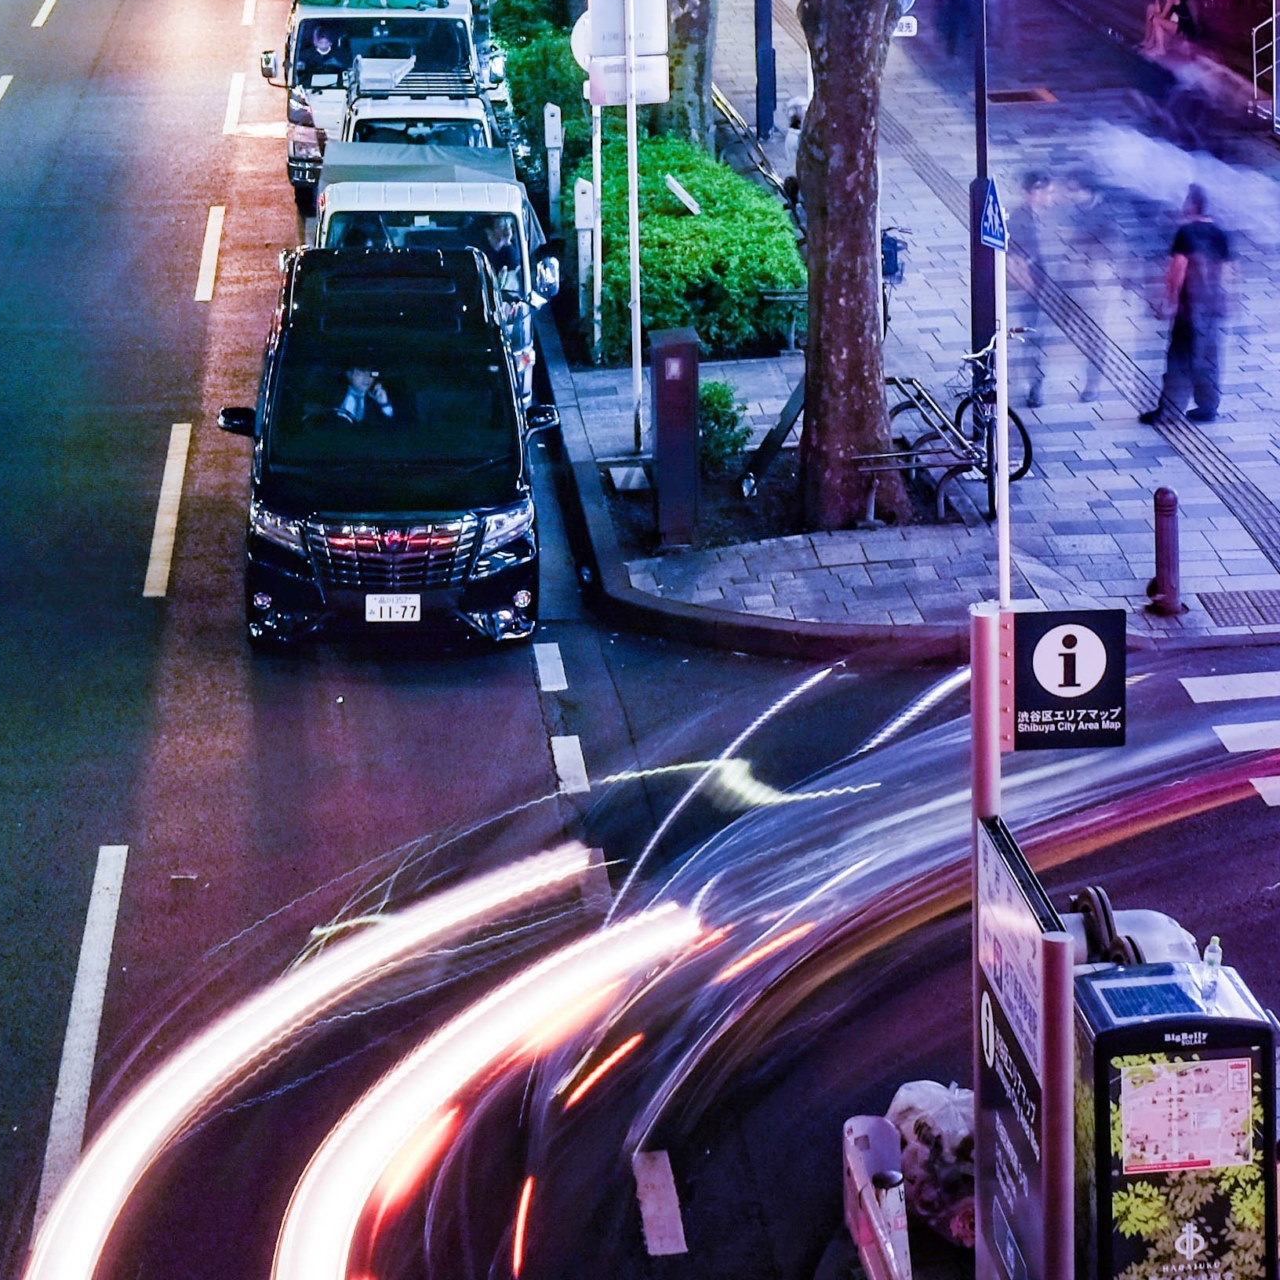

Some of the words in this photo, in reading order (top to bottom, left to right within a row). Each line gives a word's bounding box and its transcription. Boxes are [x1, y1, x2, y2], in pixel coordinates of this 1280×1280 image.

[1018, 707, 1122, 723] 渋谷区エリアマップ
[1018, 722, 1055, 734] Shibuya
[1058, 722, 1076, 733] City
[1078, 721, 1099, 731] Area
[1102, 719, 1121, 731] Map
[1164, 1031, 1208, 1043] BigBelly
